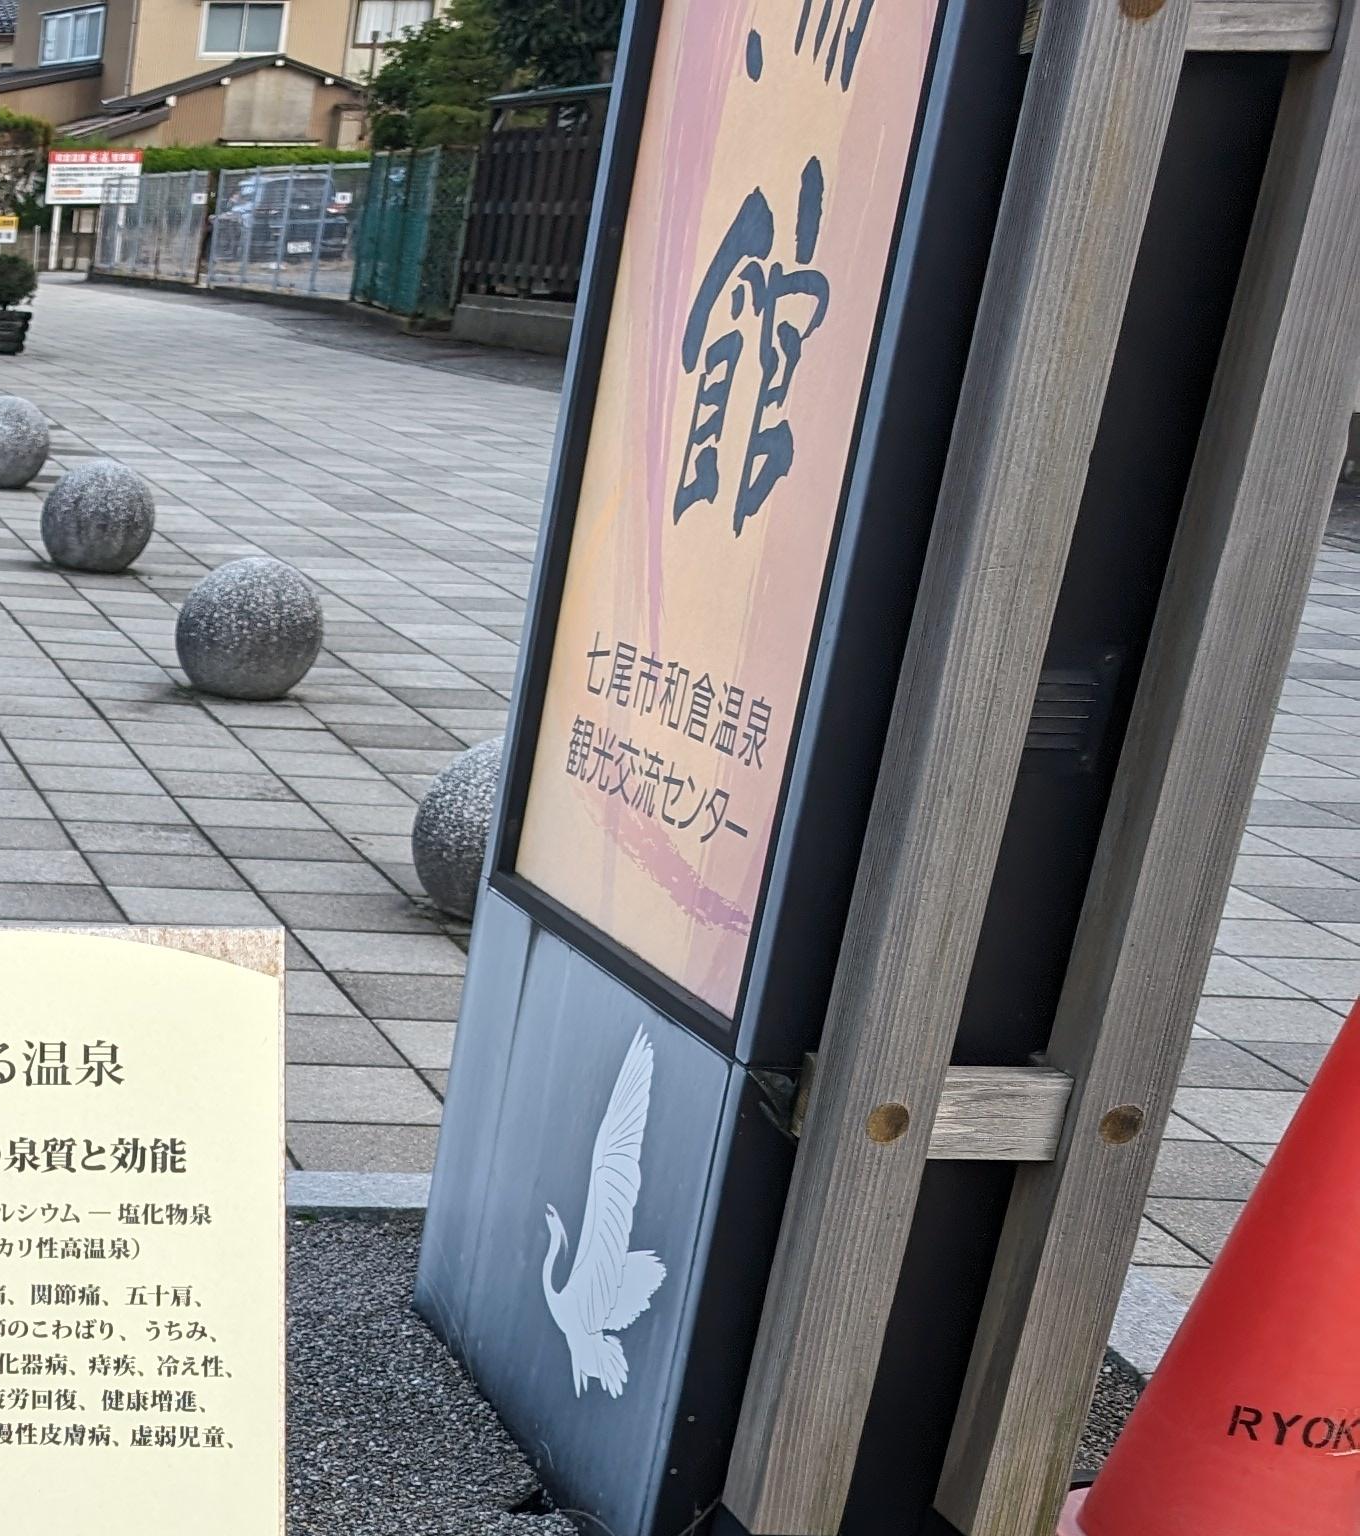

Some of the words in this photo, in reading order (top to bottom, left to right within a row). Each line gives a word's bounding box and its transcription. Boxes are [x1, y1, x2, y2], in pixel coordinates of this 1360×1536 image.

[586, 631, 773, 770] 七尾市和倉温泉
[565, 714, 749, 843] 観光交流センター
